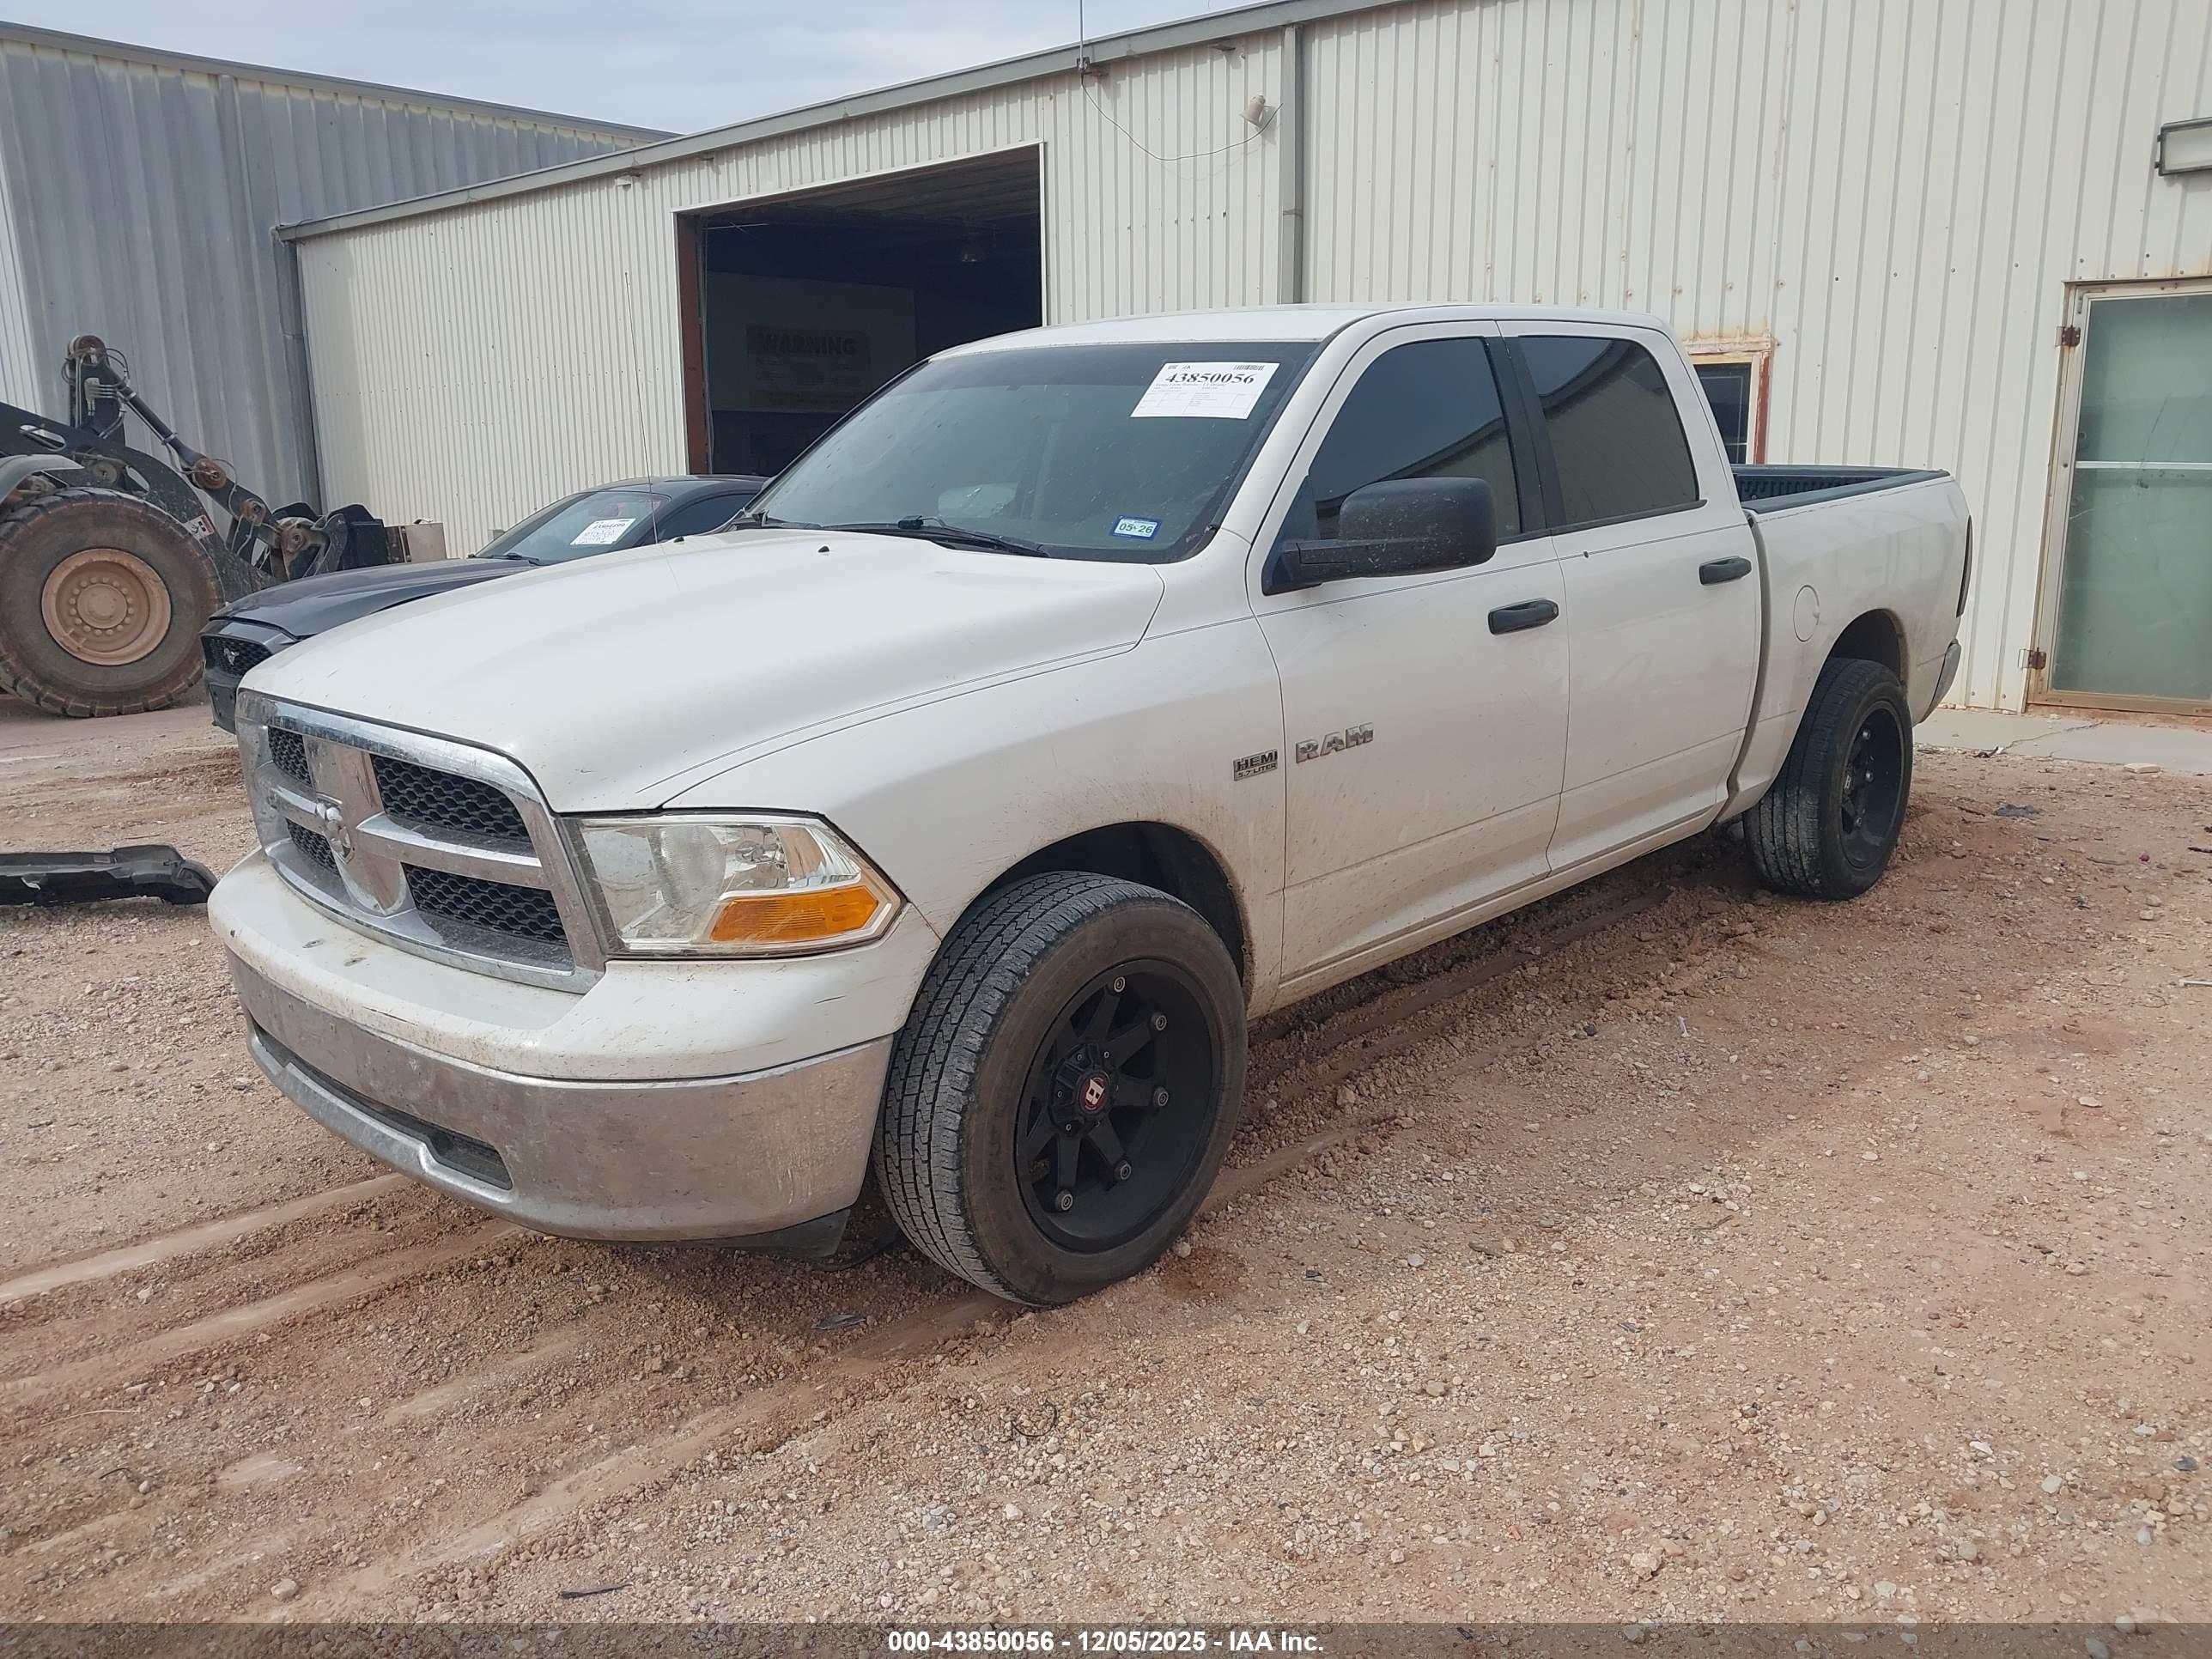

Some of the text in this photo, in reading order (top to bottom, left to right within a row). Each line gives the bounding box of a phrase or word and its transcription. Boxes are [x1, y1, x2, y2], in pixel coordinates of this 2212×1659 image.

[763, 333, 857, 355] WARNING
[1164, 372, 1257, 385] 43850056
[1295, 722, 1374, 764] RAM
[1237, 750, 1278, 772] HEMI
[1237, 762, 1277, 778] 5.7 LITER
